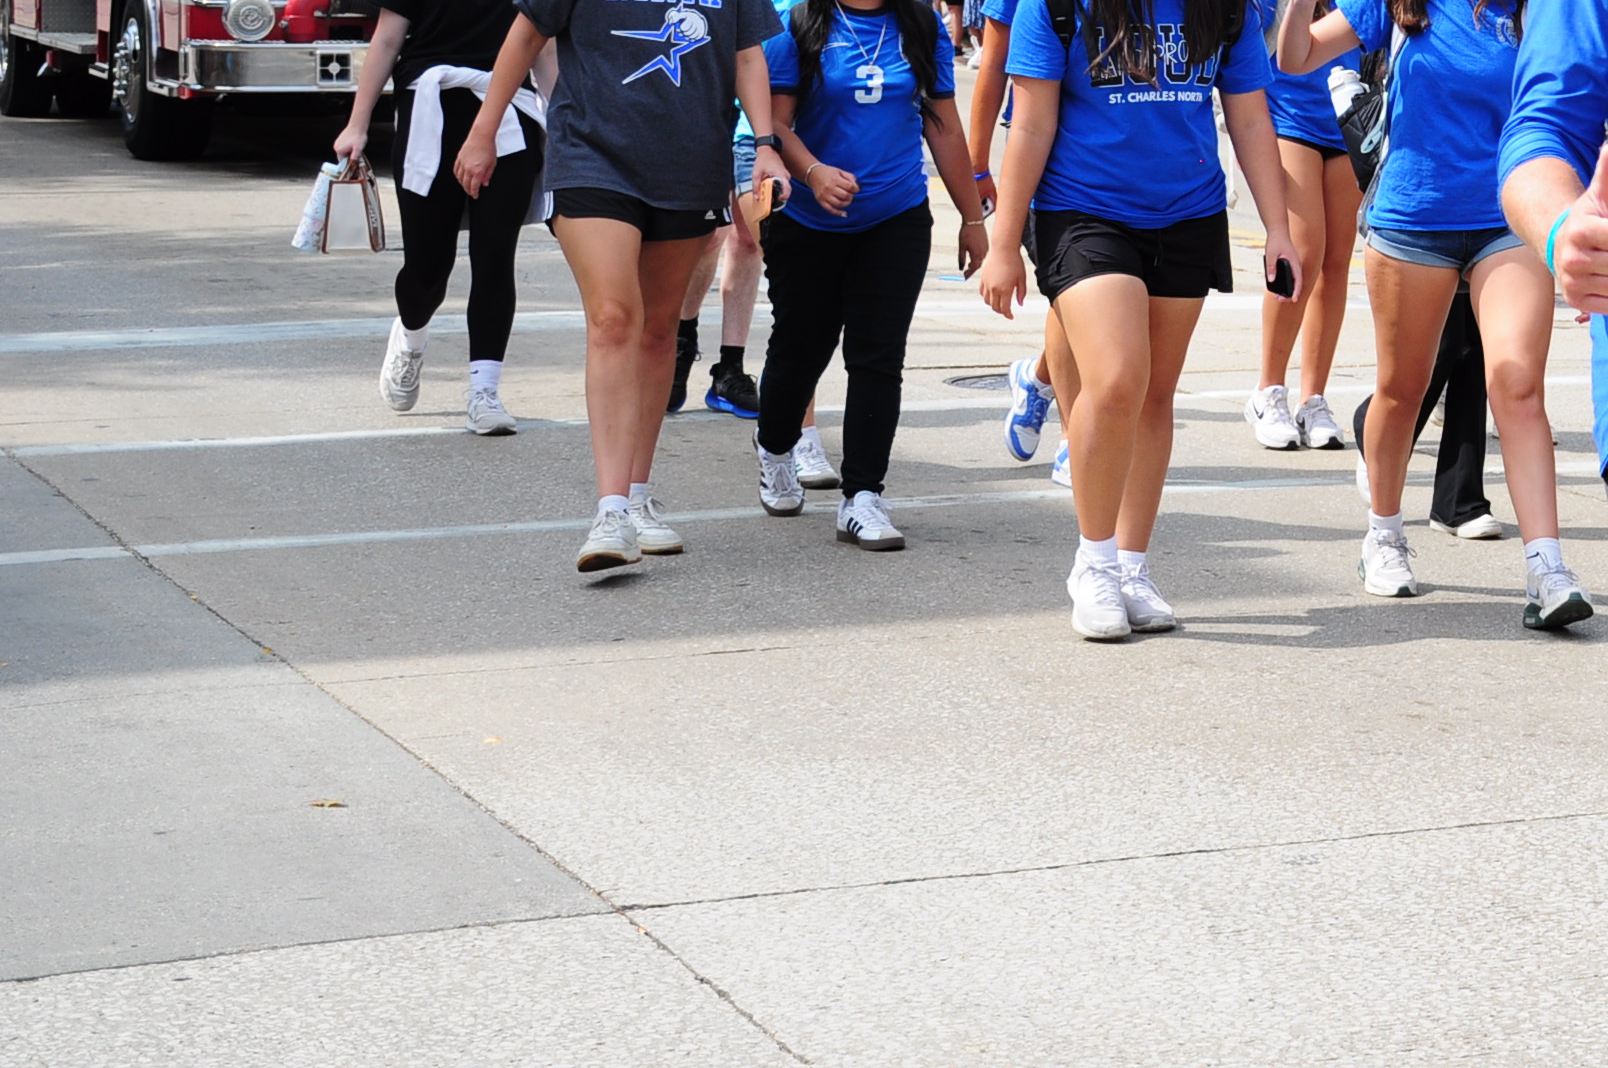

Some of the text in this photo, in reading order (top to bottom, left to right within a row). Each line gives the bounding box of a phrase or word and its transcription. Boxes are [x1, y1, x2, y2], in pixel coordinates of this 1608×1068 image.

[854, 64, 885, 104] 3
[1108, 93, 1126, 104] ST.
[1127, 90, 1176, 103] CHARLES
